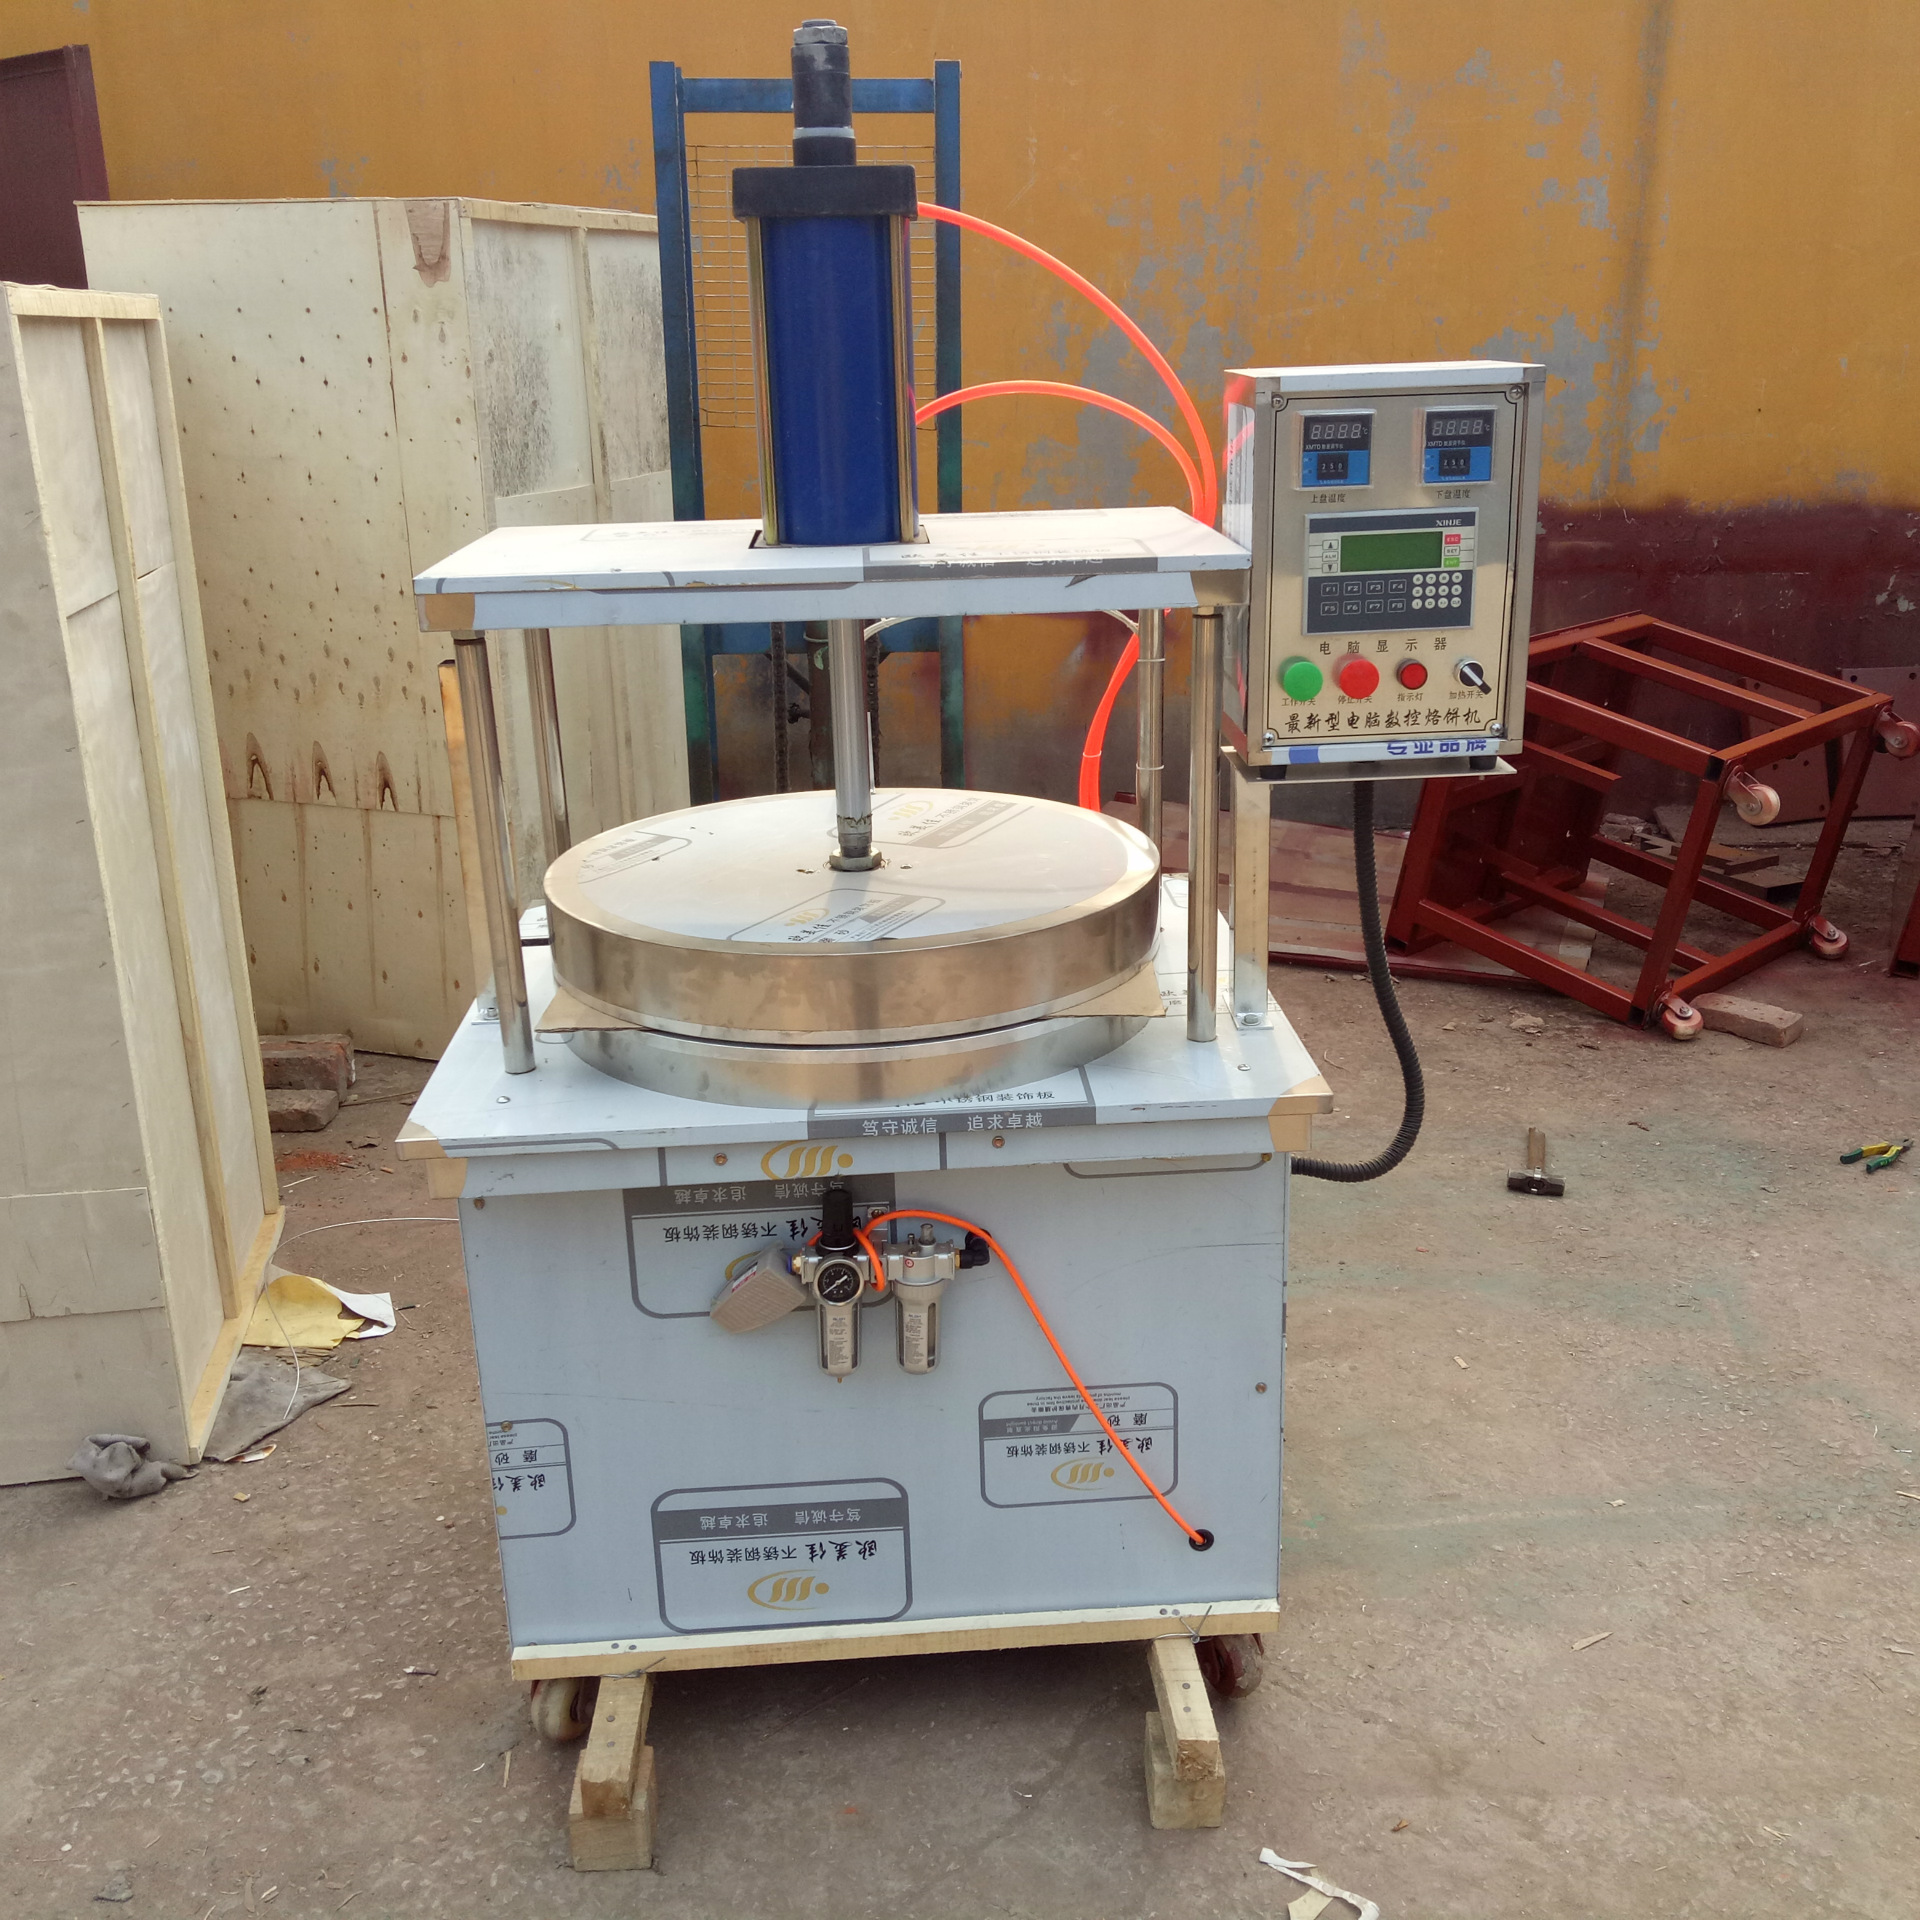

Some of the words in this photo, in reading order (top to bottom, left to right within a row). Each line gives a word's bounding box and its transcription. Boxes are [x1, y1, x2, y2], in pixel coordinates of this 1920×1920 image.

[1311, 493, 1347, 504] 上盘温度
[1437, 489, 1471, 499] 下盘温度
[1436, 519, 1462, 527] XINJE
[1397, 692, 1423, 702] 指示灯
[1449, 690, 1484, 700] 加热开关
[1285, 707, 1481, 733] 最新型电脑数控烙饼机
[862, 1117, 938, 1137] 笃守诚信
[967, 1112, 1043, 1132] 追求卓越
[674, 1186, 747, 1205] 追求卓越
[663, 1221, 777, 1242] 不锈钢装饰板
[495, 1449, 538, 1465] 磨砂
[1006, 1441, 1091, 1458] 不锈钢装饰板
[700, 1513, 768, 1531] 追求卓越
[795, 1508, 862, 1526] 笃守诚信
[690, 1545, 798, 1565] 不锈钢装饰板
[805, 1540, 878, 1562] 欧美佳
